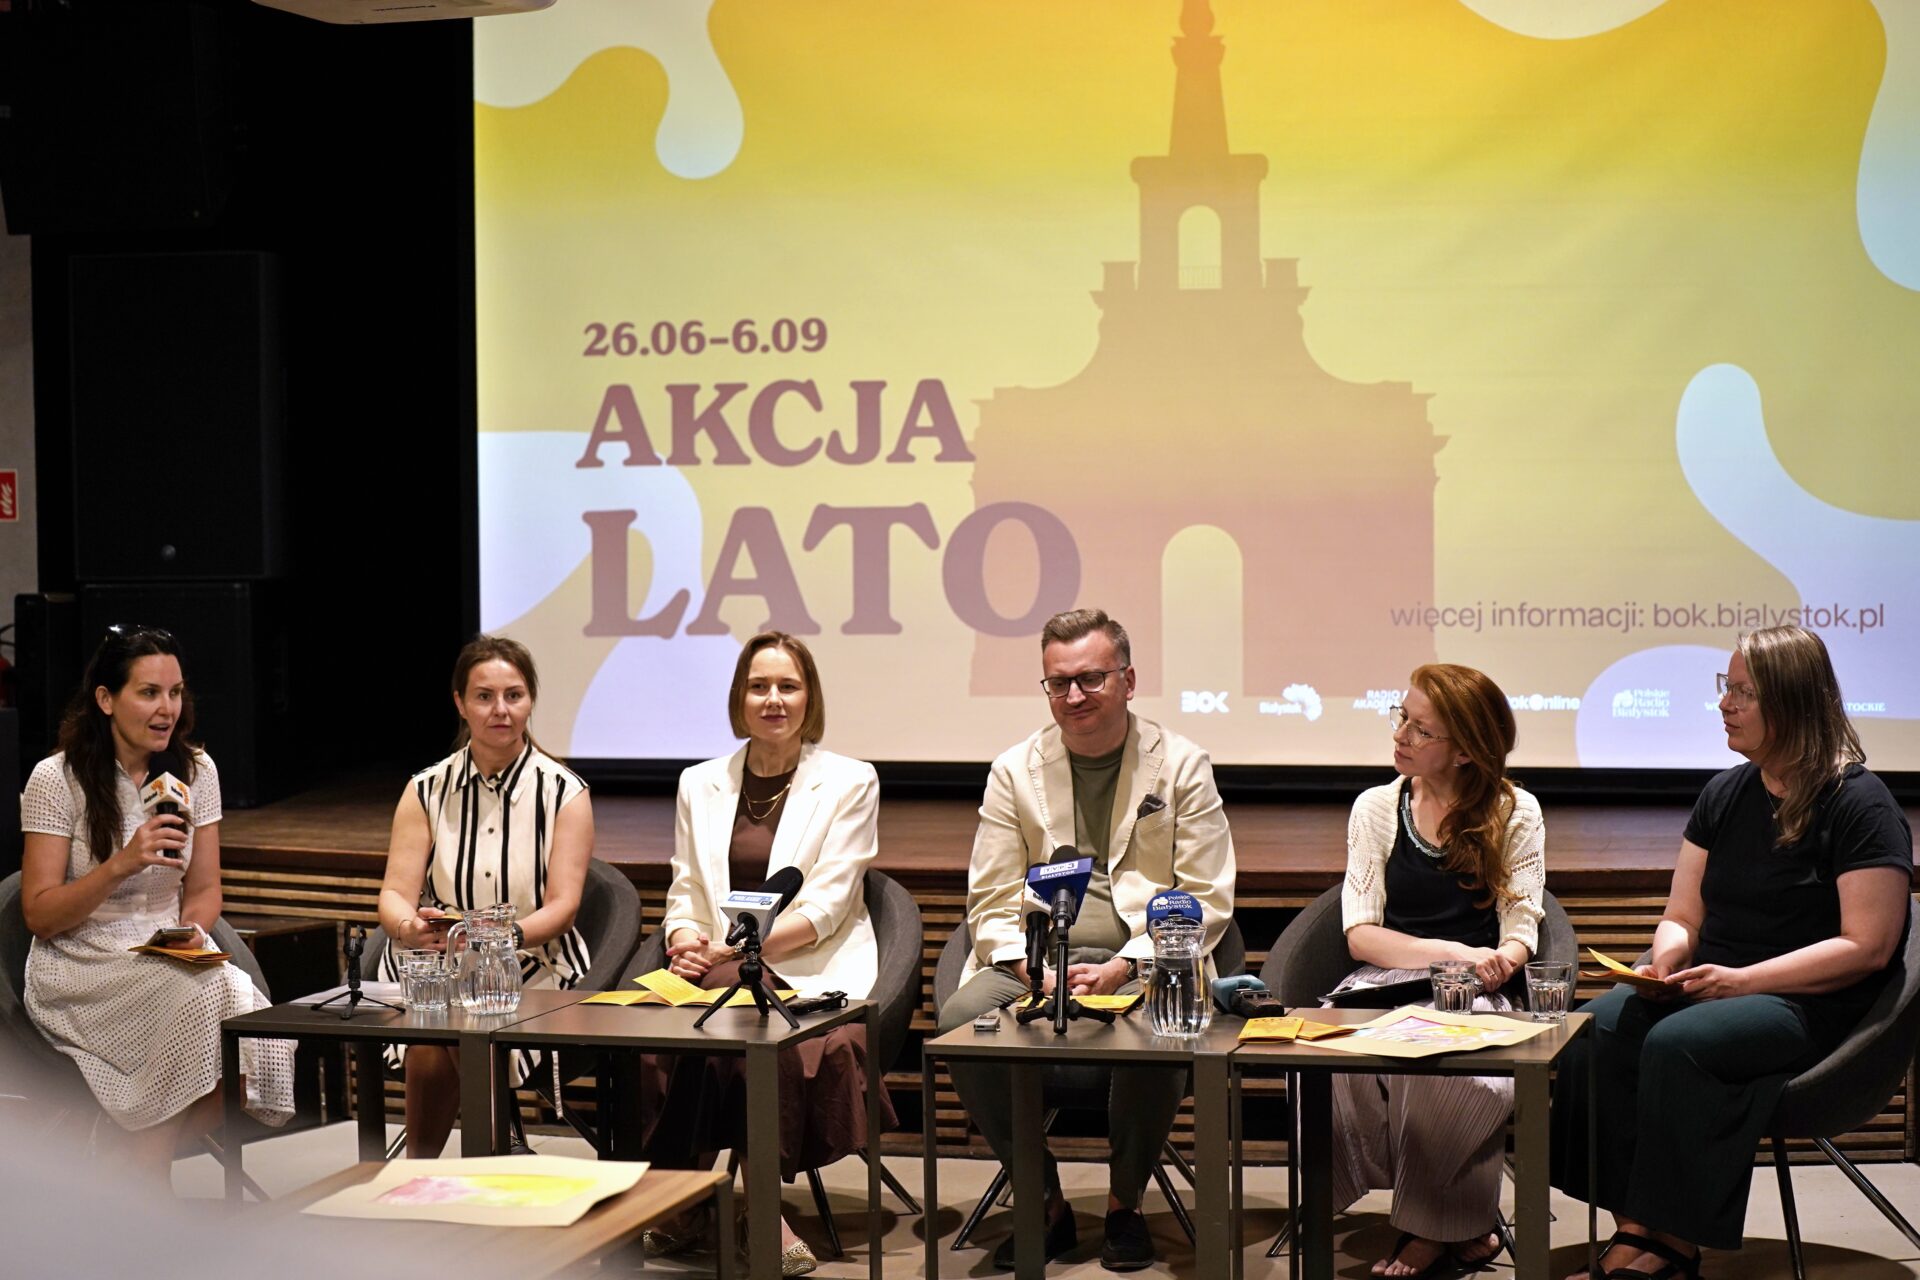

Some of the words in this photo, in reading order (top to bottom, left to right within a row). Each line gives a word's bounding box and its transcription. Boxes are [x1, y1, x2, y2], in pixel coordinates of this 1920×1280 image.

[575, 378, 977, 468] AKCJA
[581, 501, 1082, 640] LATO
[1390, 602, 1483, 633] więcej
[1491, 602, 1645, 633] informacji:
[1653, 602, 1884, 634] bok.bialystok.pl
[1633, 698, 1670, 707] Radio
